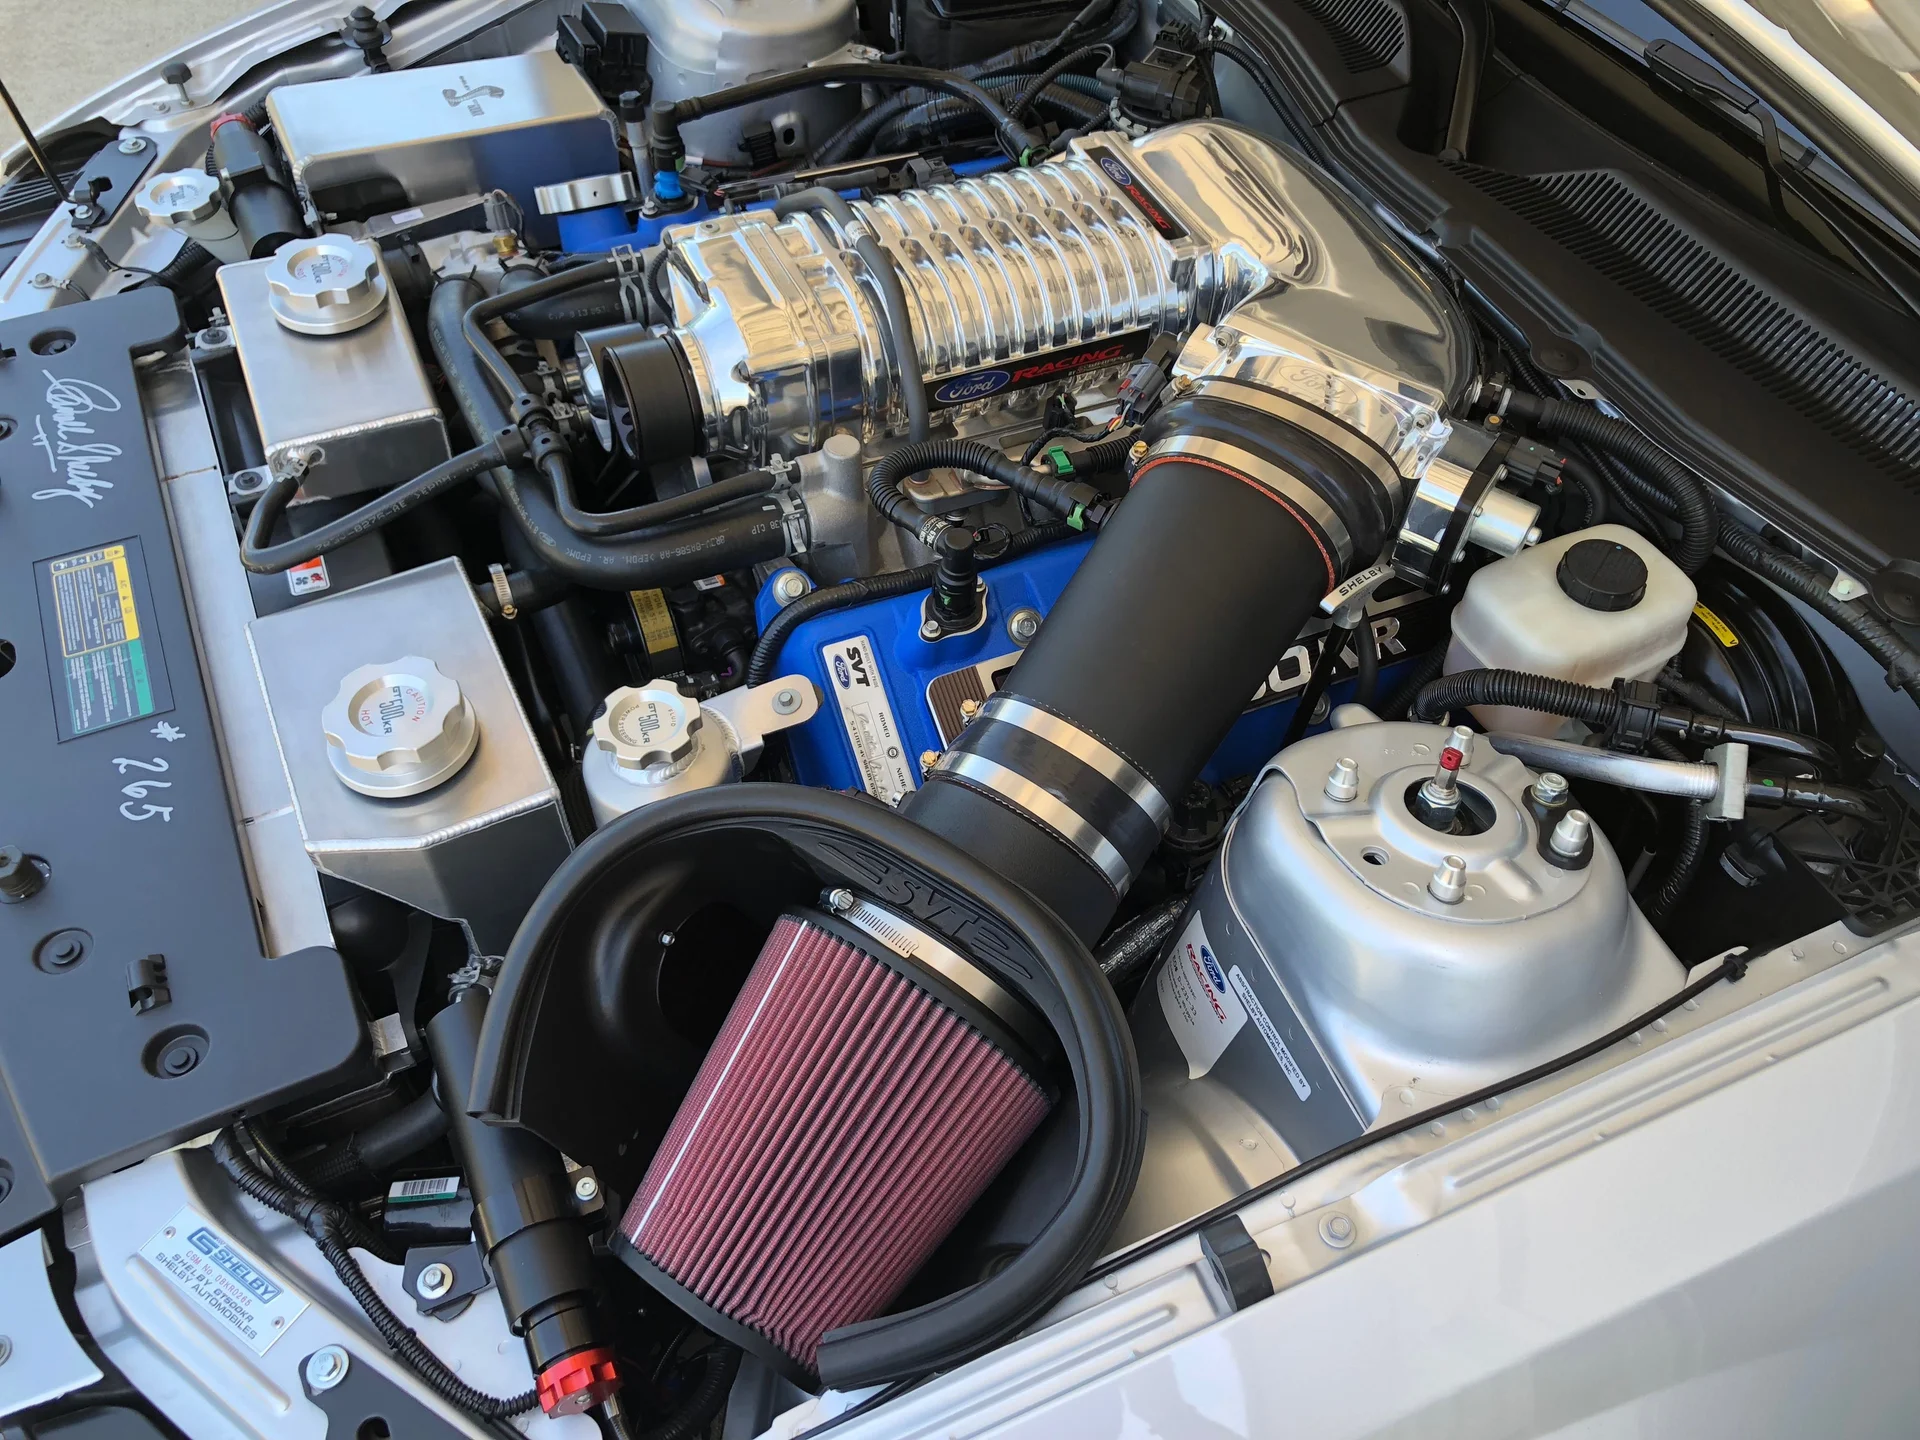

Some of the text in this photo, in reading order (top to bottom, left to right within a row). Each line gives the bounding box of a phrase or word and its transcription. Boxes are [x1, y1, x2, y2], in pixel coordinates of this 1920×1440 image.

[1125, 184, 1171, 229] RACING
[1012, 344, 1124, 383] RACING
[1338, 566, 1384, 597] SHELBY
[846, 646, 871, 687] SVT
[361, 709, 374, 727] HOT
[379, 686, 405, 735] GT500KR
[406, 688, 426, 722] CAUTION
[878, 711, 891, 738] ROMEO
[1185, 943, 1228, 1021] RACING
[1240, 992, 1257, 1017] SHELBY
[1234, 972, 1306, 1088] ABS/TRACTION CONTROL MODIFIED BY
[185, 1250, 202, 1266] CSM
[213, 1247, 276, 1301] SHELBY
[155, 1252, 258, 1340] SHELBY AUTOMOBILES
[171, 1253, 254, 1323] SHELBY GT500KR
